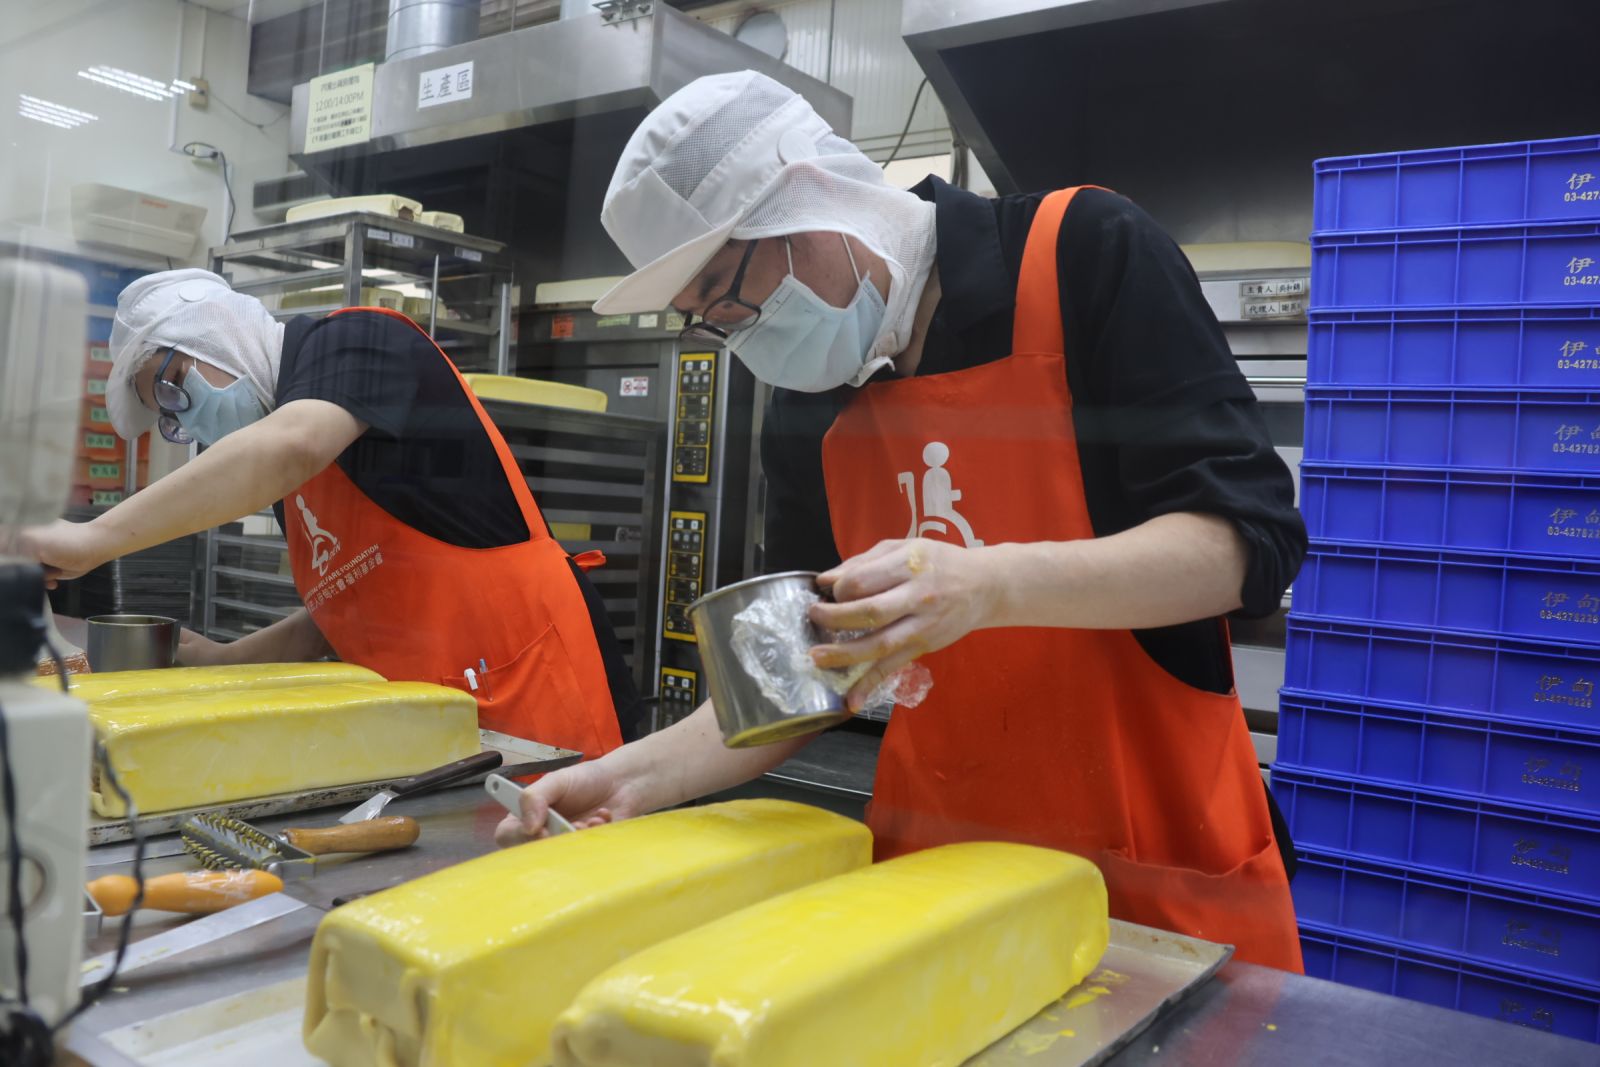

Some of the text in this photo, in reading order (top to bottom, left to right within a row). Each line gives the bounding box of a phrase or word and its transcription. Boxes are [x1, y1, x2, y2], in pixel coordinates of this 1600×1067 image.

[420, 69, 470, 101] 生產區
[1566, 173, 1595, 191] 伊
[1564, 190, 1600, 202] 03-427
[1566, 256, 1595, 274] 伊
[1564, 275, 1600, 286] 03-427
[1560, 340, 1600, 358] 伊
[340, 544, 380, 573] FOUNDATION
